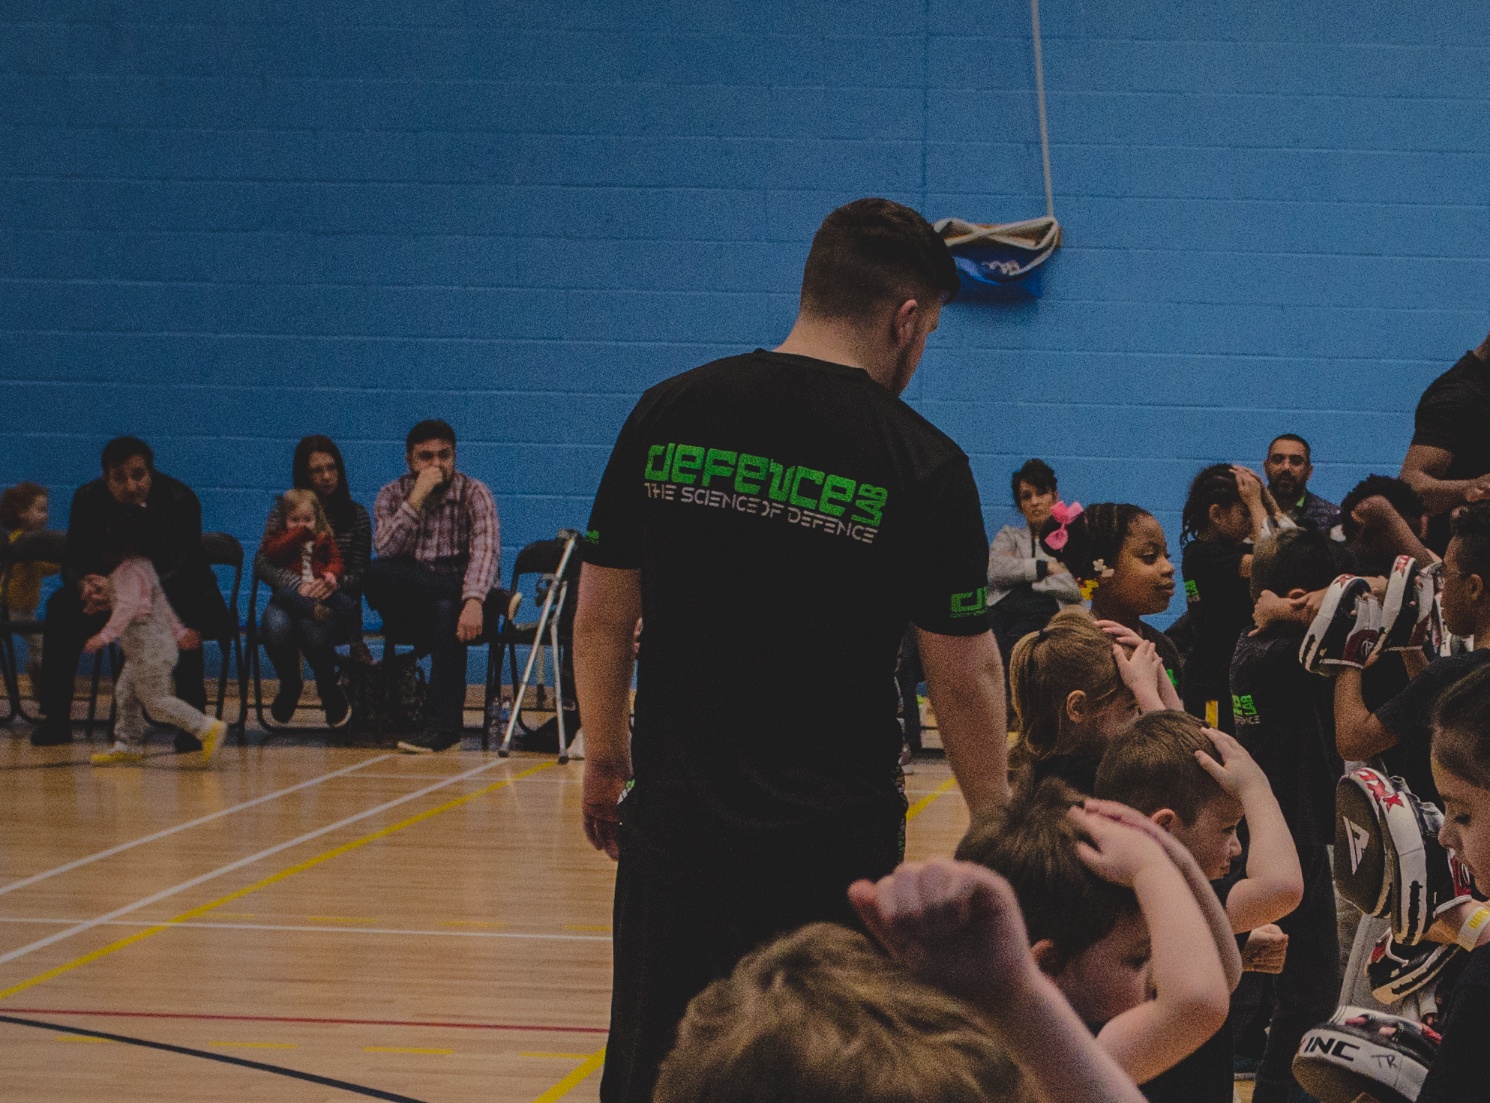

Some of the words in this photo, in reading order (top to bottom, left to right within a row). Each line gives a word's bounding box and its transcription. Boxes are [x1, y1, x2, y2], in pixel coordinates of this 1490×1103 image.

[643, 482, 678, 501] THE
[680, 486, 761, 514] SCIENCE
[760, 500, 786, 518] OF
[787, 507, 879, 544] DEFENCE
[1304, 1037, 1360, 1062] INC
